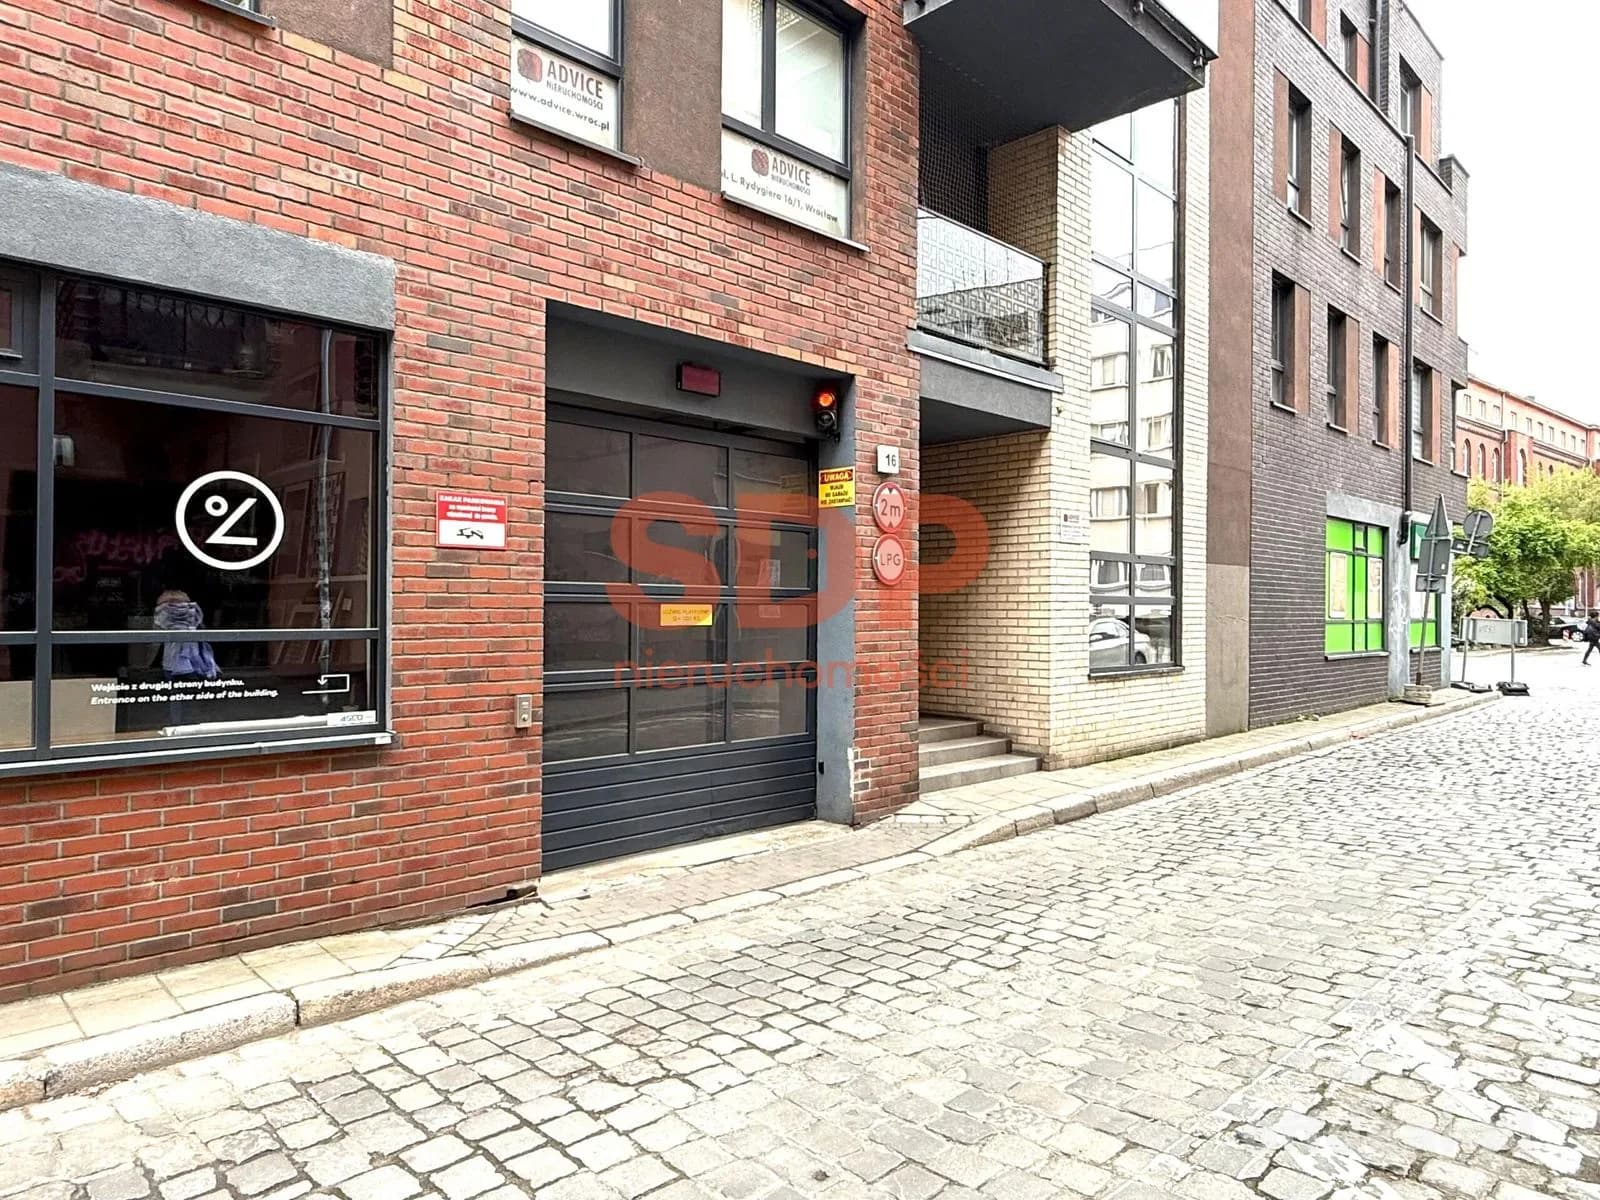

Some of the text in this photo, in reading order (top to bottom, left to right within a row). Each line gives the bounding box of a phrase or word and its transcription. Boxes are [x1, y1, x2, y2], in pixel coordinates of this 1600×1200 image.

[547, 60, 603, 99] ADVICE
[546, 80, 604, 110] NIERUCHOMOŚCI
[510, 87, 610, 131] www.advice.wroc.pl
[772, 157, 811, 186] ADVICE
[740, 176, 782, 201] Rydygiera
[885, 454, 897, 467] 16
[824, 472, 849, 482] UWAGA
[880, 553, 901, 567] LPG
[91, 682, 129, 693] Wejście
[139, 681, 172, 691] drugiej
[173, 681, 203, 689] strony
[204, 679, 244, 688] budynku.
[91, 696, 136, 705] Entrance
[151, 694, 168, 702] the
[169, 692, 195, 701] other
[195, 691, 215, 700] side
[216, 690, 227, 699] of
[228, 690, 242, 698] the
[243, 689, 279, 698] building.
